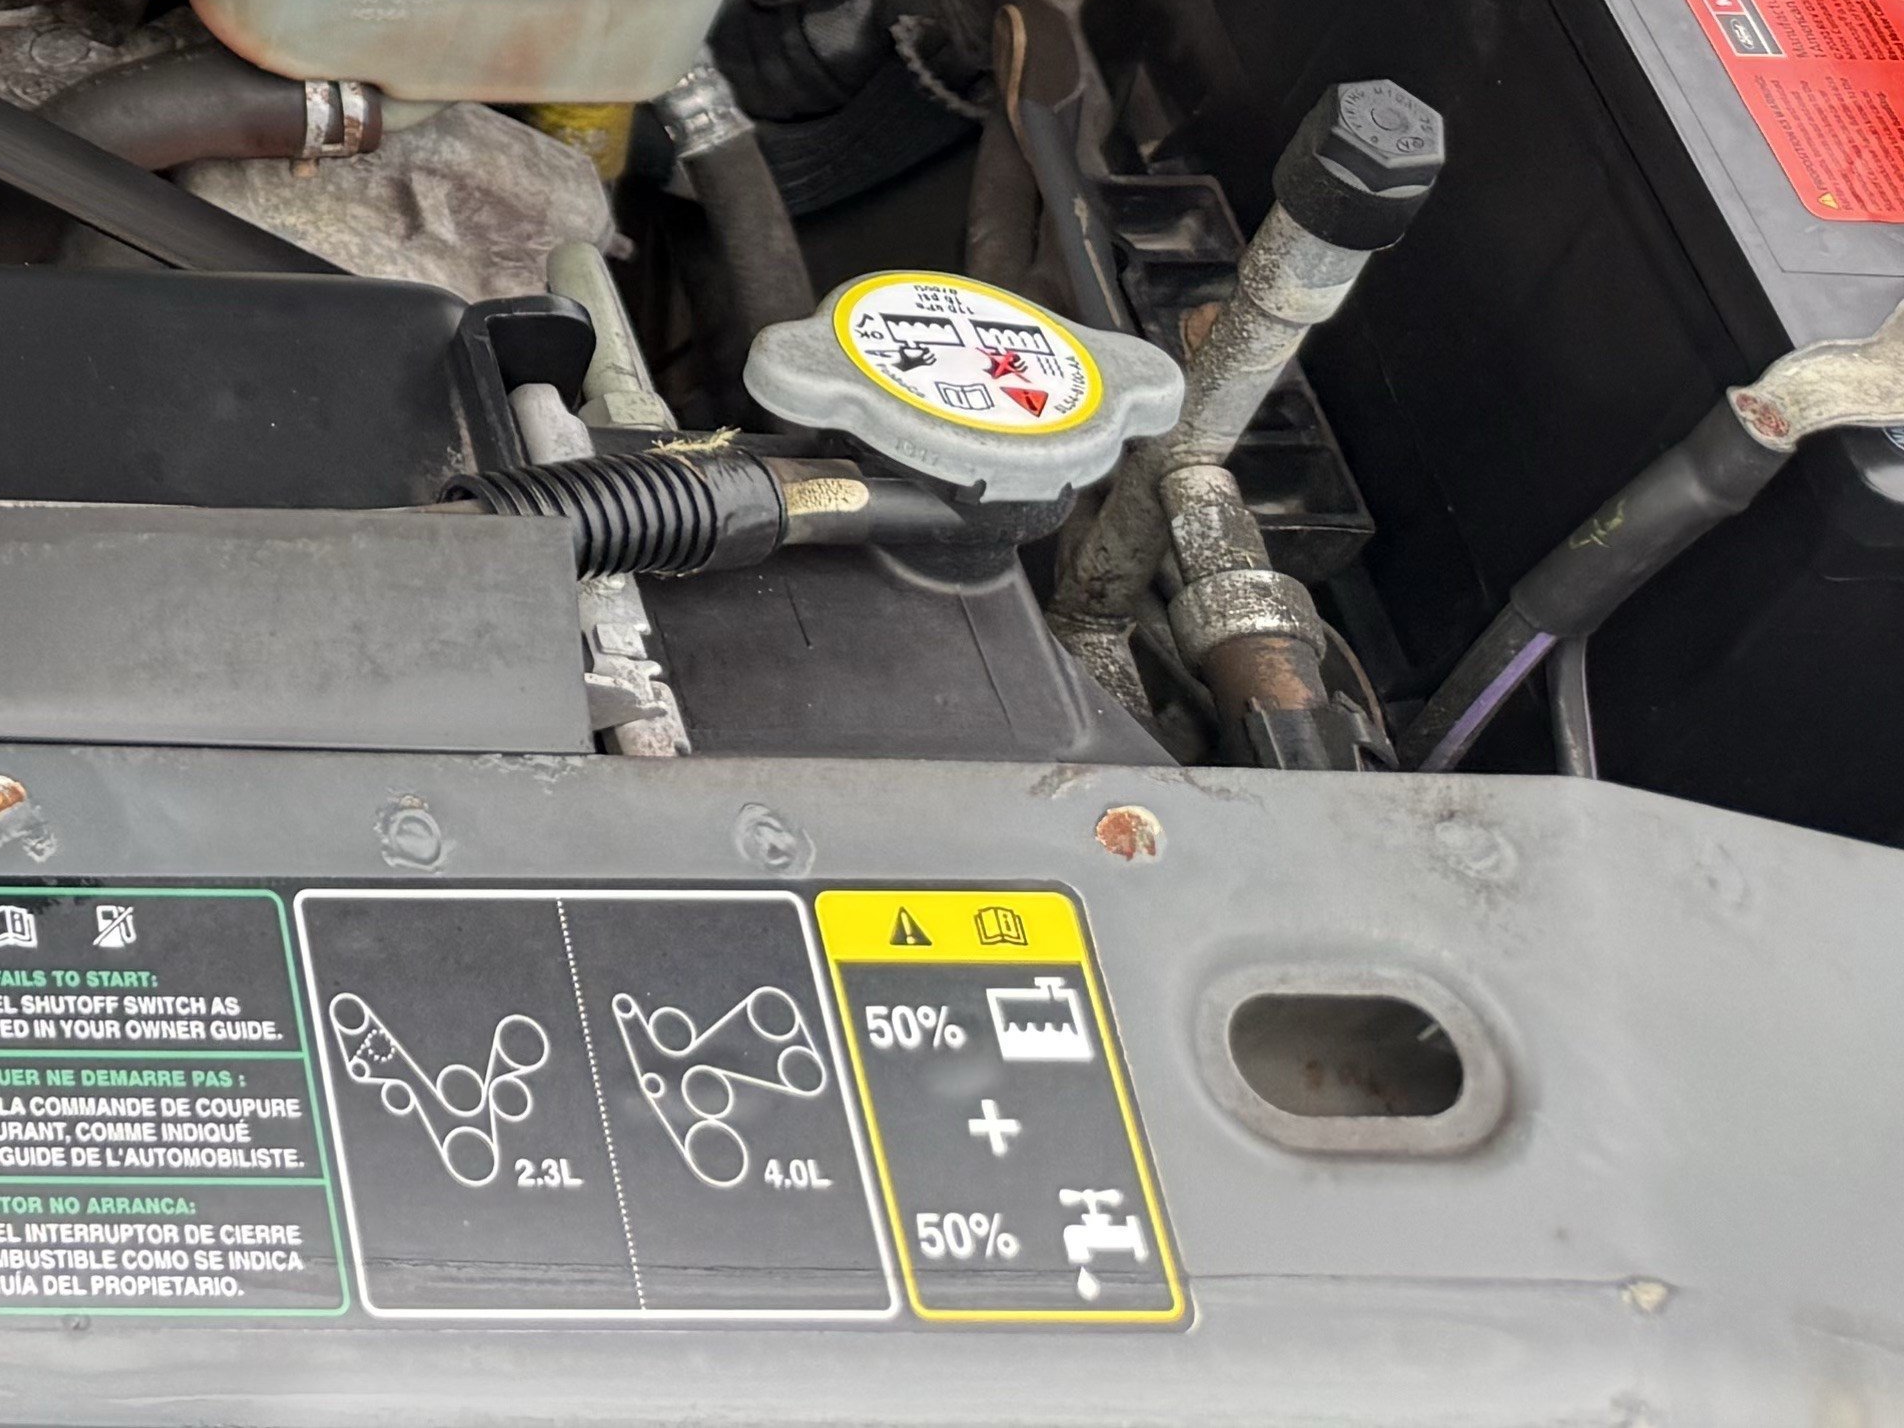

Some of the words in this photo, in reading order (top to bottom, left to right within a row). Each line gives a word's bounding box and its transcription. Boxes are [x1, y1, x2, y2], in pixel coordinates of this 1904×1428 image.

[855, 329, 884, 341] OK
[50, 969, 80, 987] TO
[85, 970, 158, 988] START:
[863, 1002, 965, 1051] 50%
[513, 1158, 583, 1190] 2.3L
[763, 1158, 832, 1191] 4.0L
[48, 1195, 80, 1215] NO
[86, 1196, 196, 1215] ARRANCA:
[916, 1210, 1020, 1262] 50%
